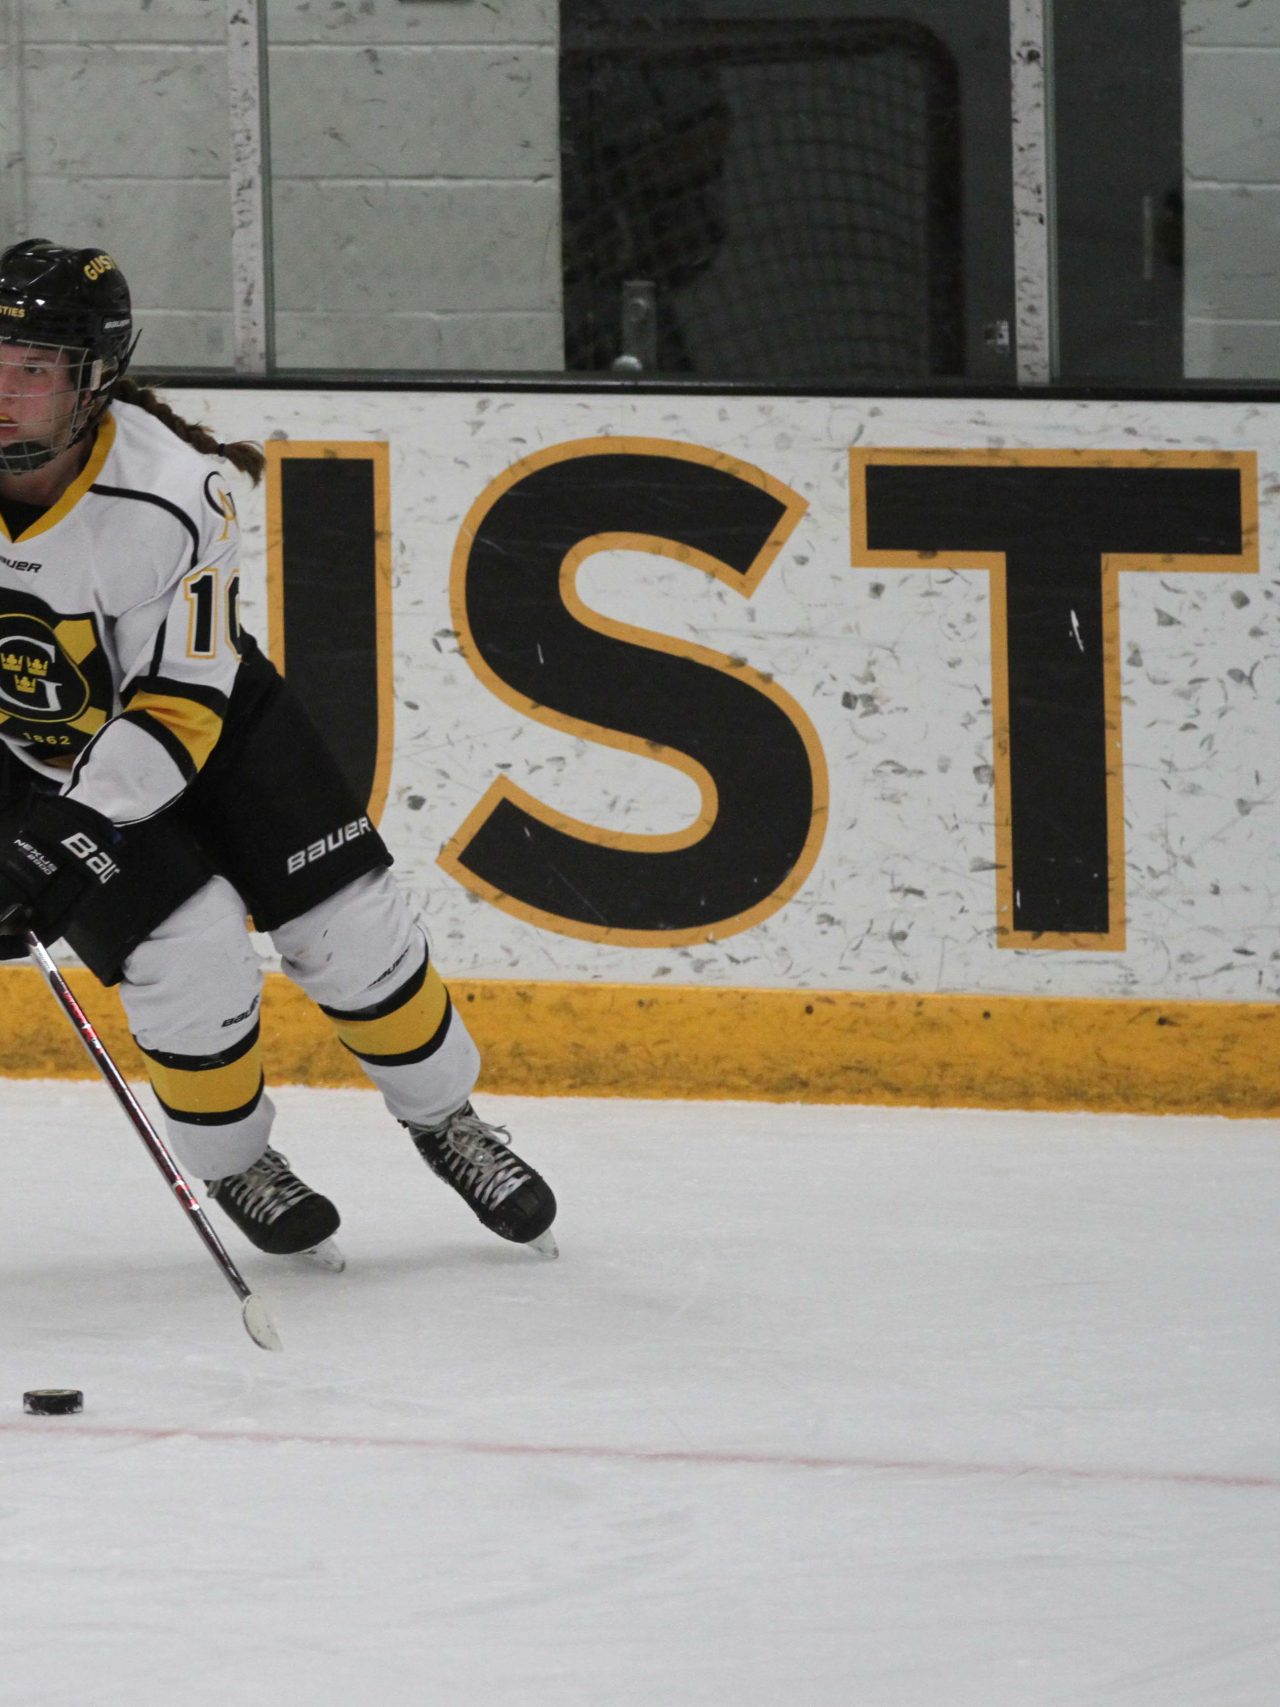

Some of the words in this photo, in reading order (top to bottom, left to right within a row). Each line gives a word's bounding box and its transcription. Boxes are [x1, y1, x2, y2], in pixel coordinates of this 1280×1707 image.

[83, 255, 117, 281] GUS
[23, 732, 71, 745] 1862
[287, 816, 371, 876] BAUER
